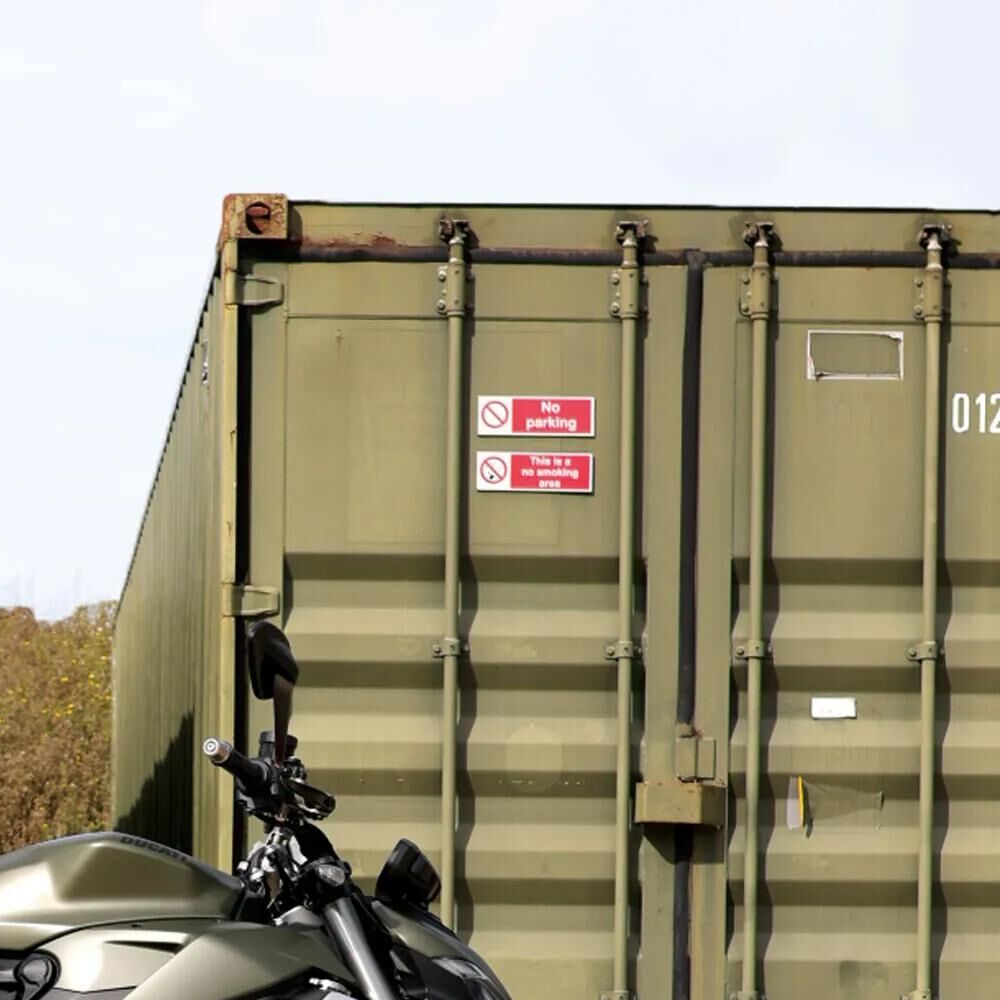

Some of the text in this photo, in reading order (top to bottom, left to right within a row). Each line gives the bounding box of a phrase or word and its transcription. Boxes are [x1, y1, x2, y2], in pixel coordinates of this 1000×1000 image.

[540, 400, 561, 414] No
[951, 392, 1000, 434] 012
[525, 416, 578, 432] parking
[530, 456, 571, 467] This is a
[521, 468, 579, 480] no smoking
[538, 481, 561, 489] area
